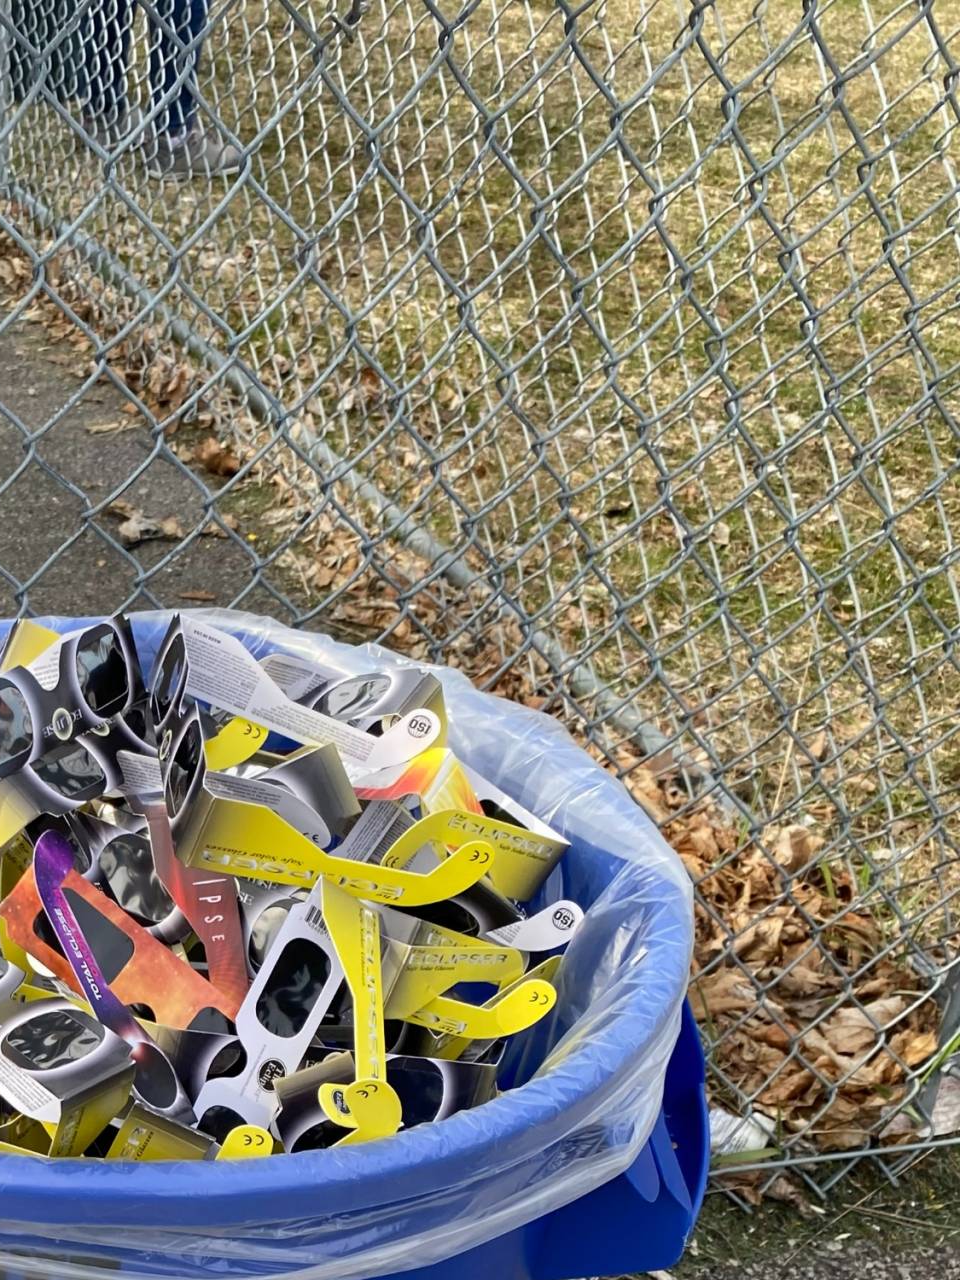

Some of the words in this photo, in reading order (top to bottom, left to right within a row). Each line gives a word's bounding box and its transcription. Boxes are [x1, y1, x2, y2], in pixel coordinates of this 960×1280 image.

[244, 724, 261, 739] CE
[409, 719, 431, 735] ISO
[250, 852, 278, 862] Solar
[280, 856, 303, 867] Safe
[469, 849, 490, 863] CE
[553, 910, 574, 928] ISO
[54, 908, 83, 958] ECLIPSE
[81, 961, 102, 1000] TOTAL
[529, 991, 548, 1005] CE
[357, 1083, 378, 1098] CE
[244, 1134, 265, 1146] CE
